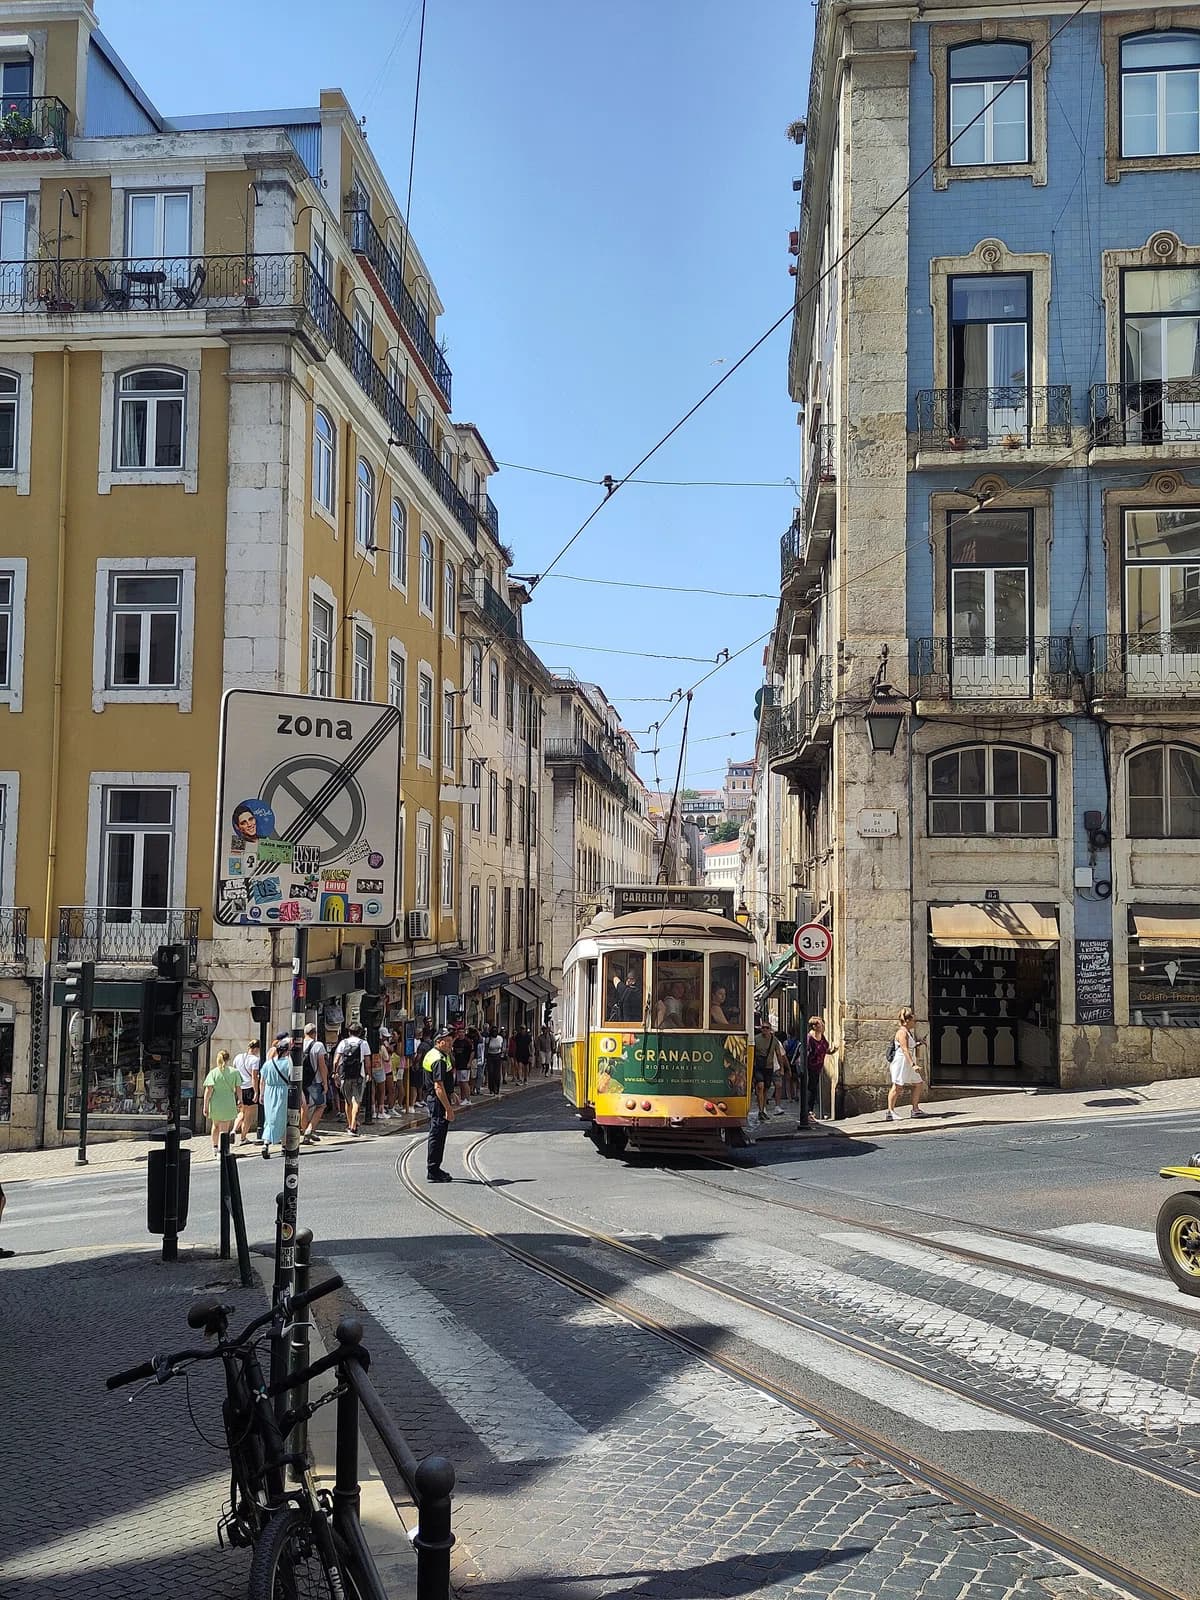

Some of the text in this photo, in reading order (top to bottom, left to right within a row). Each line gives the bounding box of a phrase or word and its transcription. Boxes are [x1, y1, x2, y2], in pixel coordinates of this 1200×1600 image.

[277, 714, 353, 740] zona
[292, 861, 320, 874] RTE
[622, 892, 670, 903] CARREIRA
[703, 894, 719, 906] 28
[1080, 1008, 1113, 1021] WAFFLES
[634, 1049, 714, 1063] GRANADO
